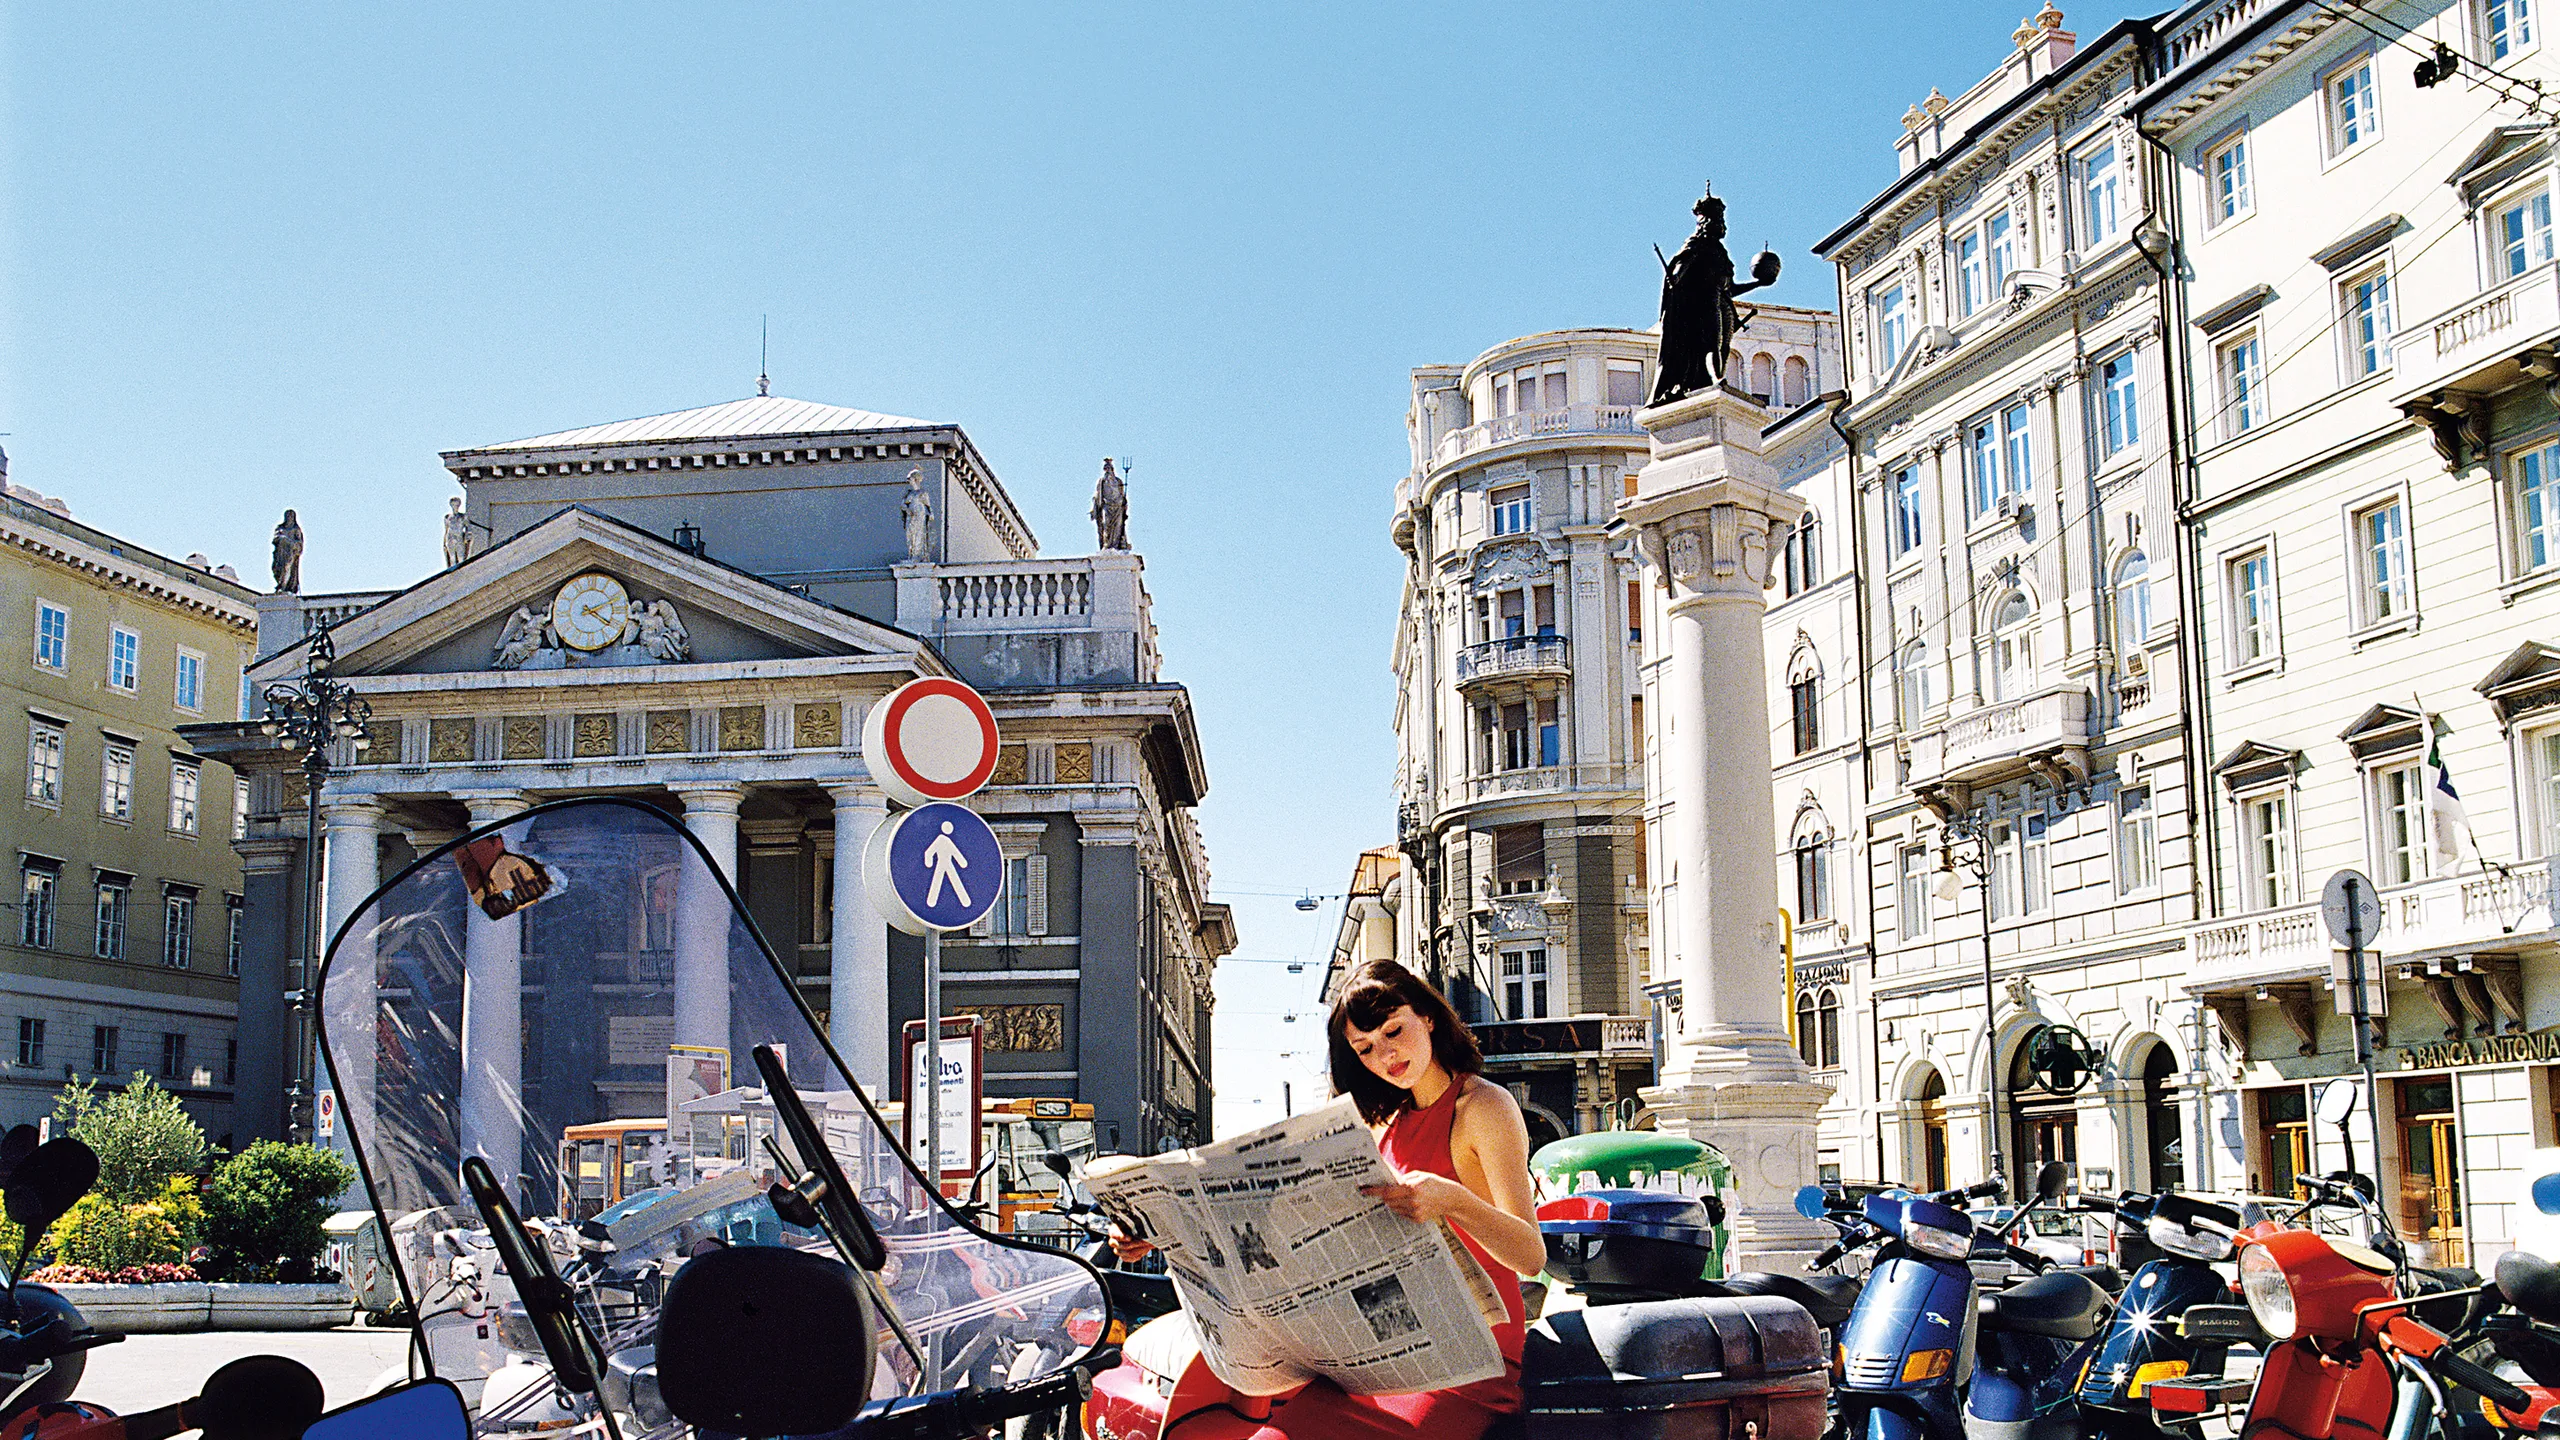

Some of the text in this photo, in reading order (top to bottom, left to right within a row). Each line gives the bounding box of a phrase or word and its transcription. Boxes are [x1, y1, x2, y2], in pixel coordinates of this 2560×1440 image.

[1488, 1023, 1582, 1052] RSA
[2418, 1033, 2560, 1069] BANCA ANTONIA
[920, 1054, 962, 1077] Slva
[920, 1076, 964, 1087] aramenti
